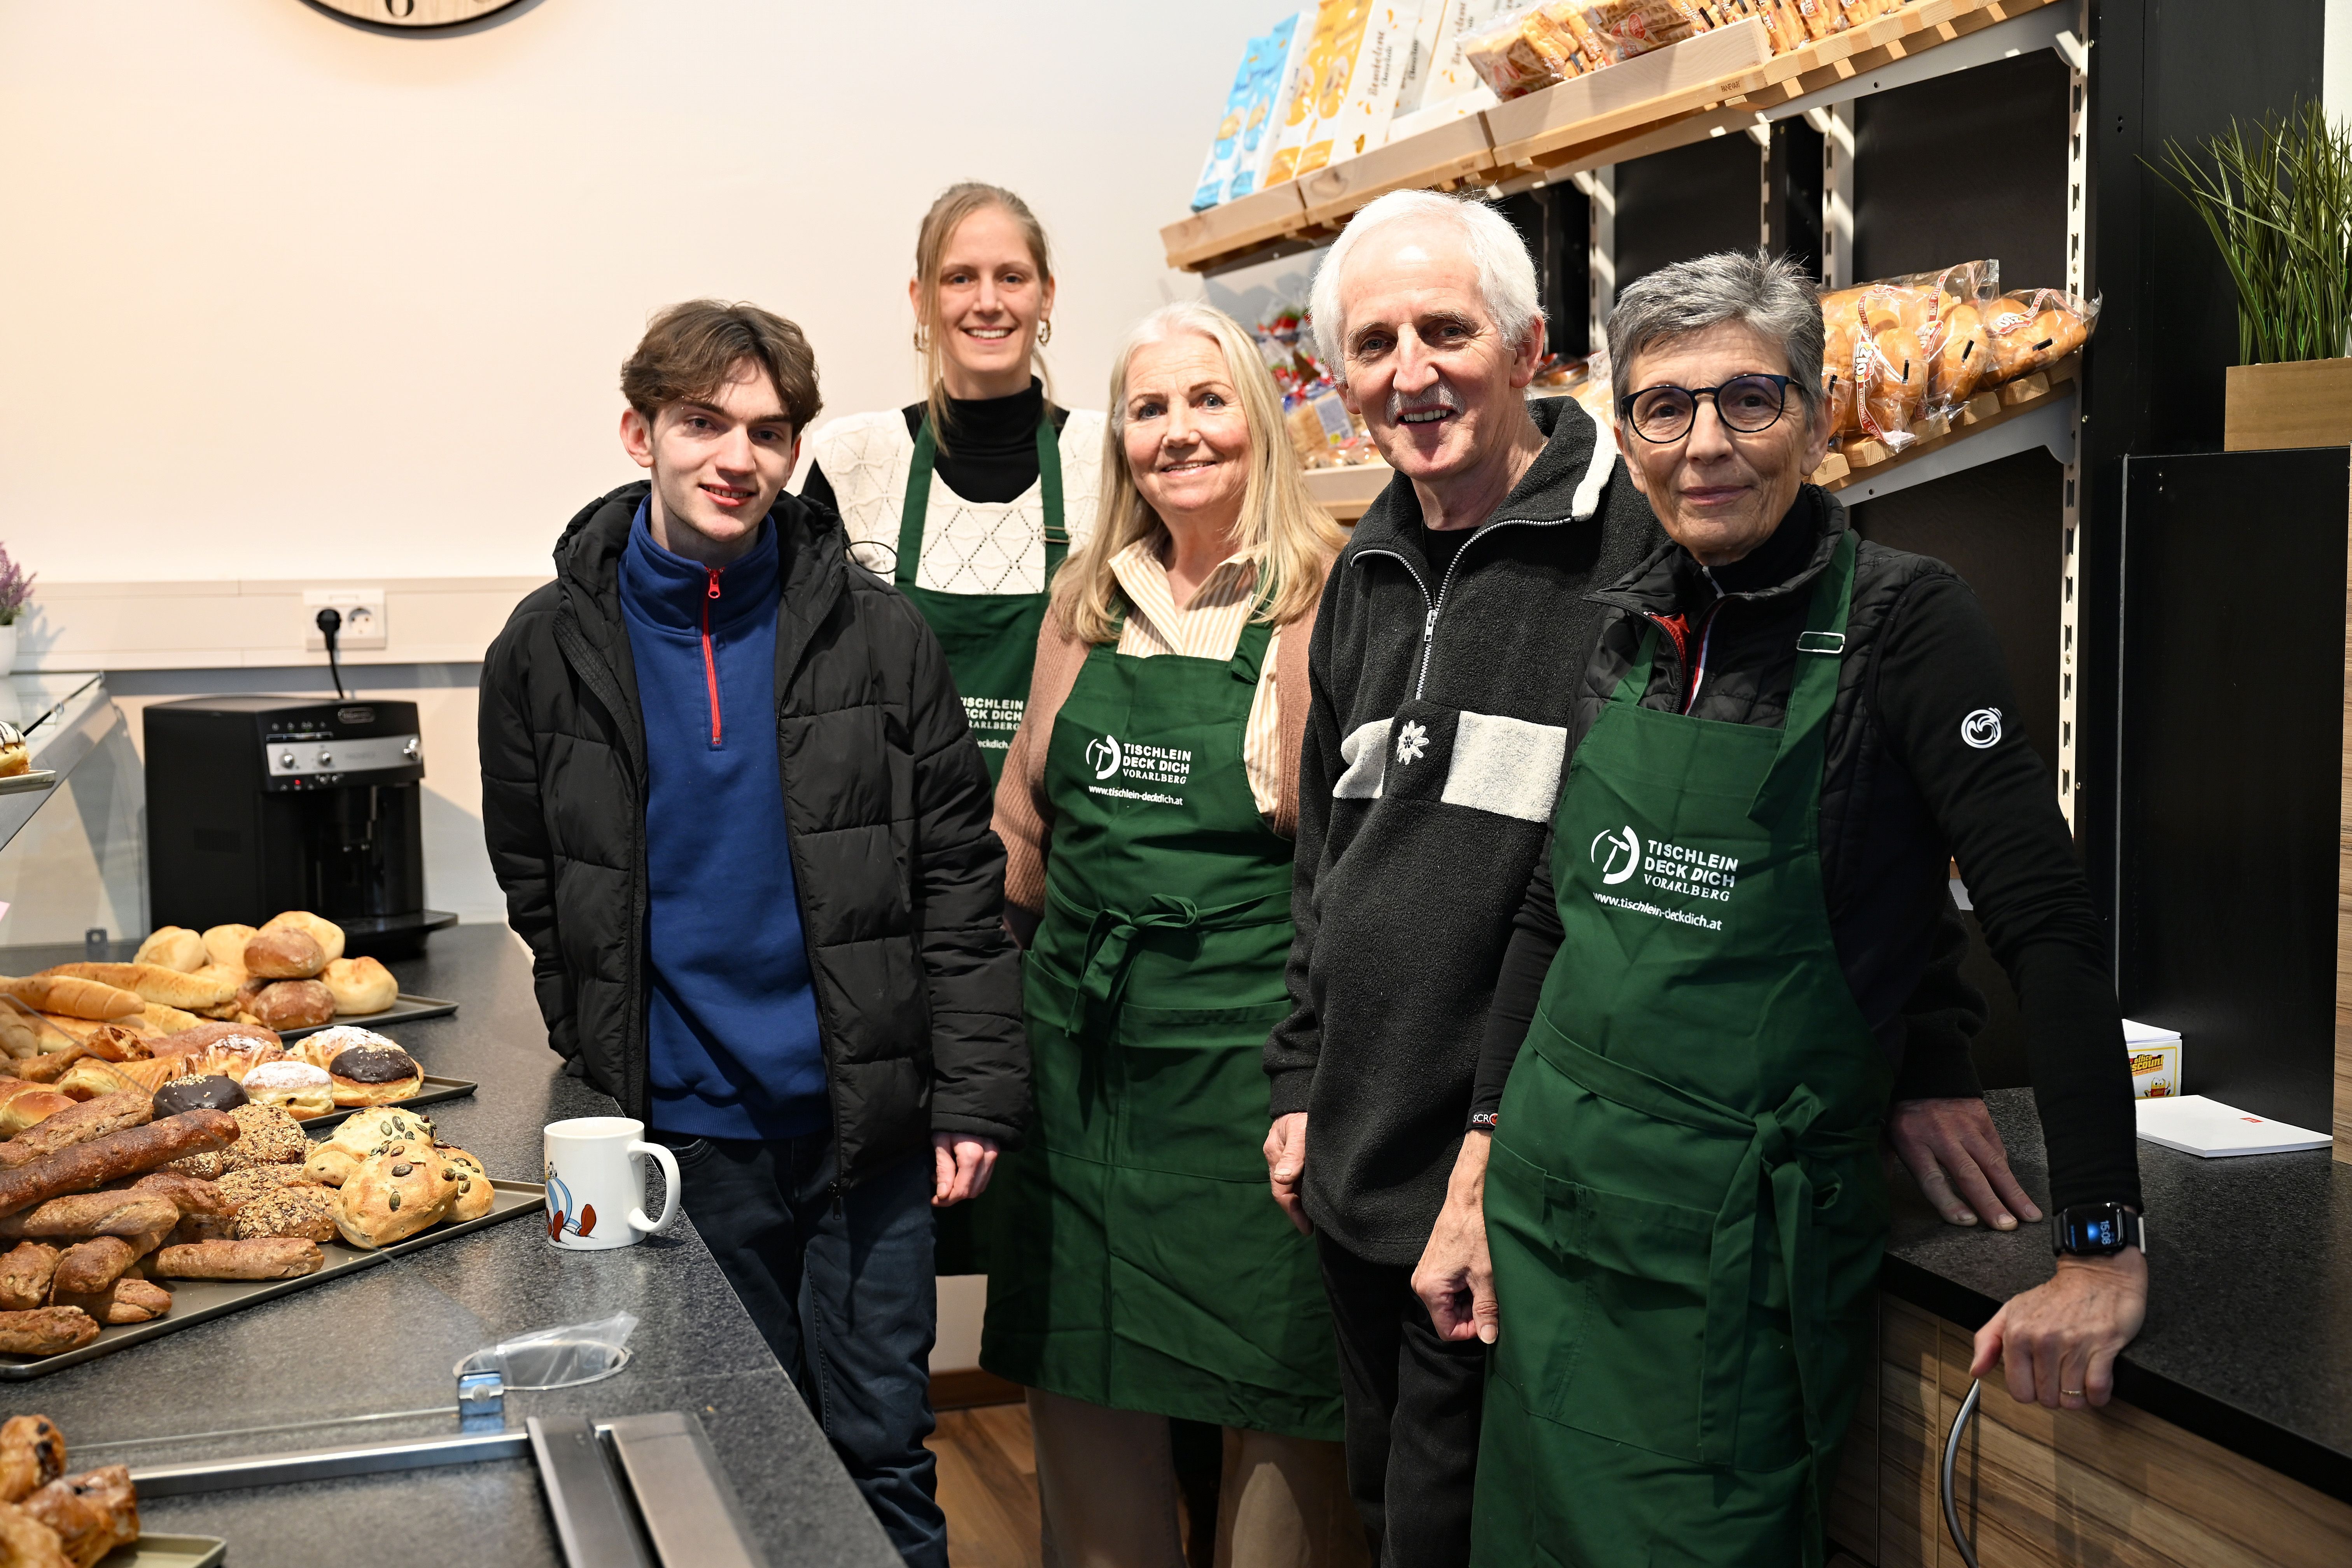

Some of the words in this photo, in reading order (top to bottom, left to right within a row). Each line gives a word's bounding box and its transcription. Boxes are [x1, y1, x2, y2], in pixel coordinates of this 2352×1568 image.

[965, 708, 988, 719] ECK
[992, 710, 1022, 721] DICH
[968, 719, 1020, 731] RARLBERG
[1124, 743, 1192, 761] TISCHLEIN
[1122, 755, 1156, 770] DECK
[1159, 760, 1190, 774] DICH
[1122, 768, 1187, 784] VORARLBERG
[1088, 786, 1183, 805] www.tischlein-deckdich.at
[1648, 840, 1738, 872] TISCHLEIN
[1644, 856, 1689, 879] DECK
[1690, 868, 1735, 888] DICH
[1644, 873, 1730, 901] VORARLBERG
[1593, 892, 1722, 931] www.tischlein-deckdich.at
[2130, 1054, 2164, 1072] scount
[2134, 1054, 2152, 1064] office
